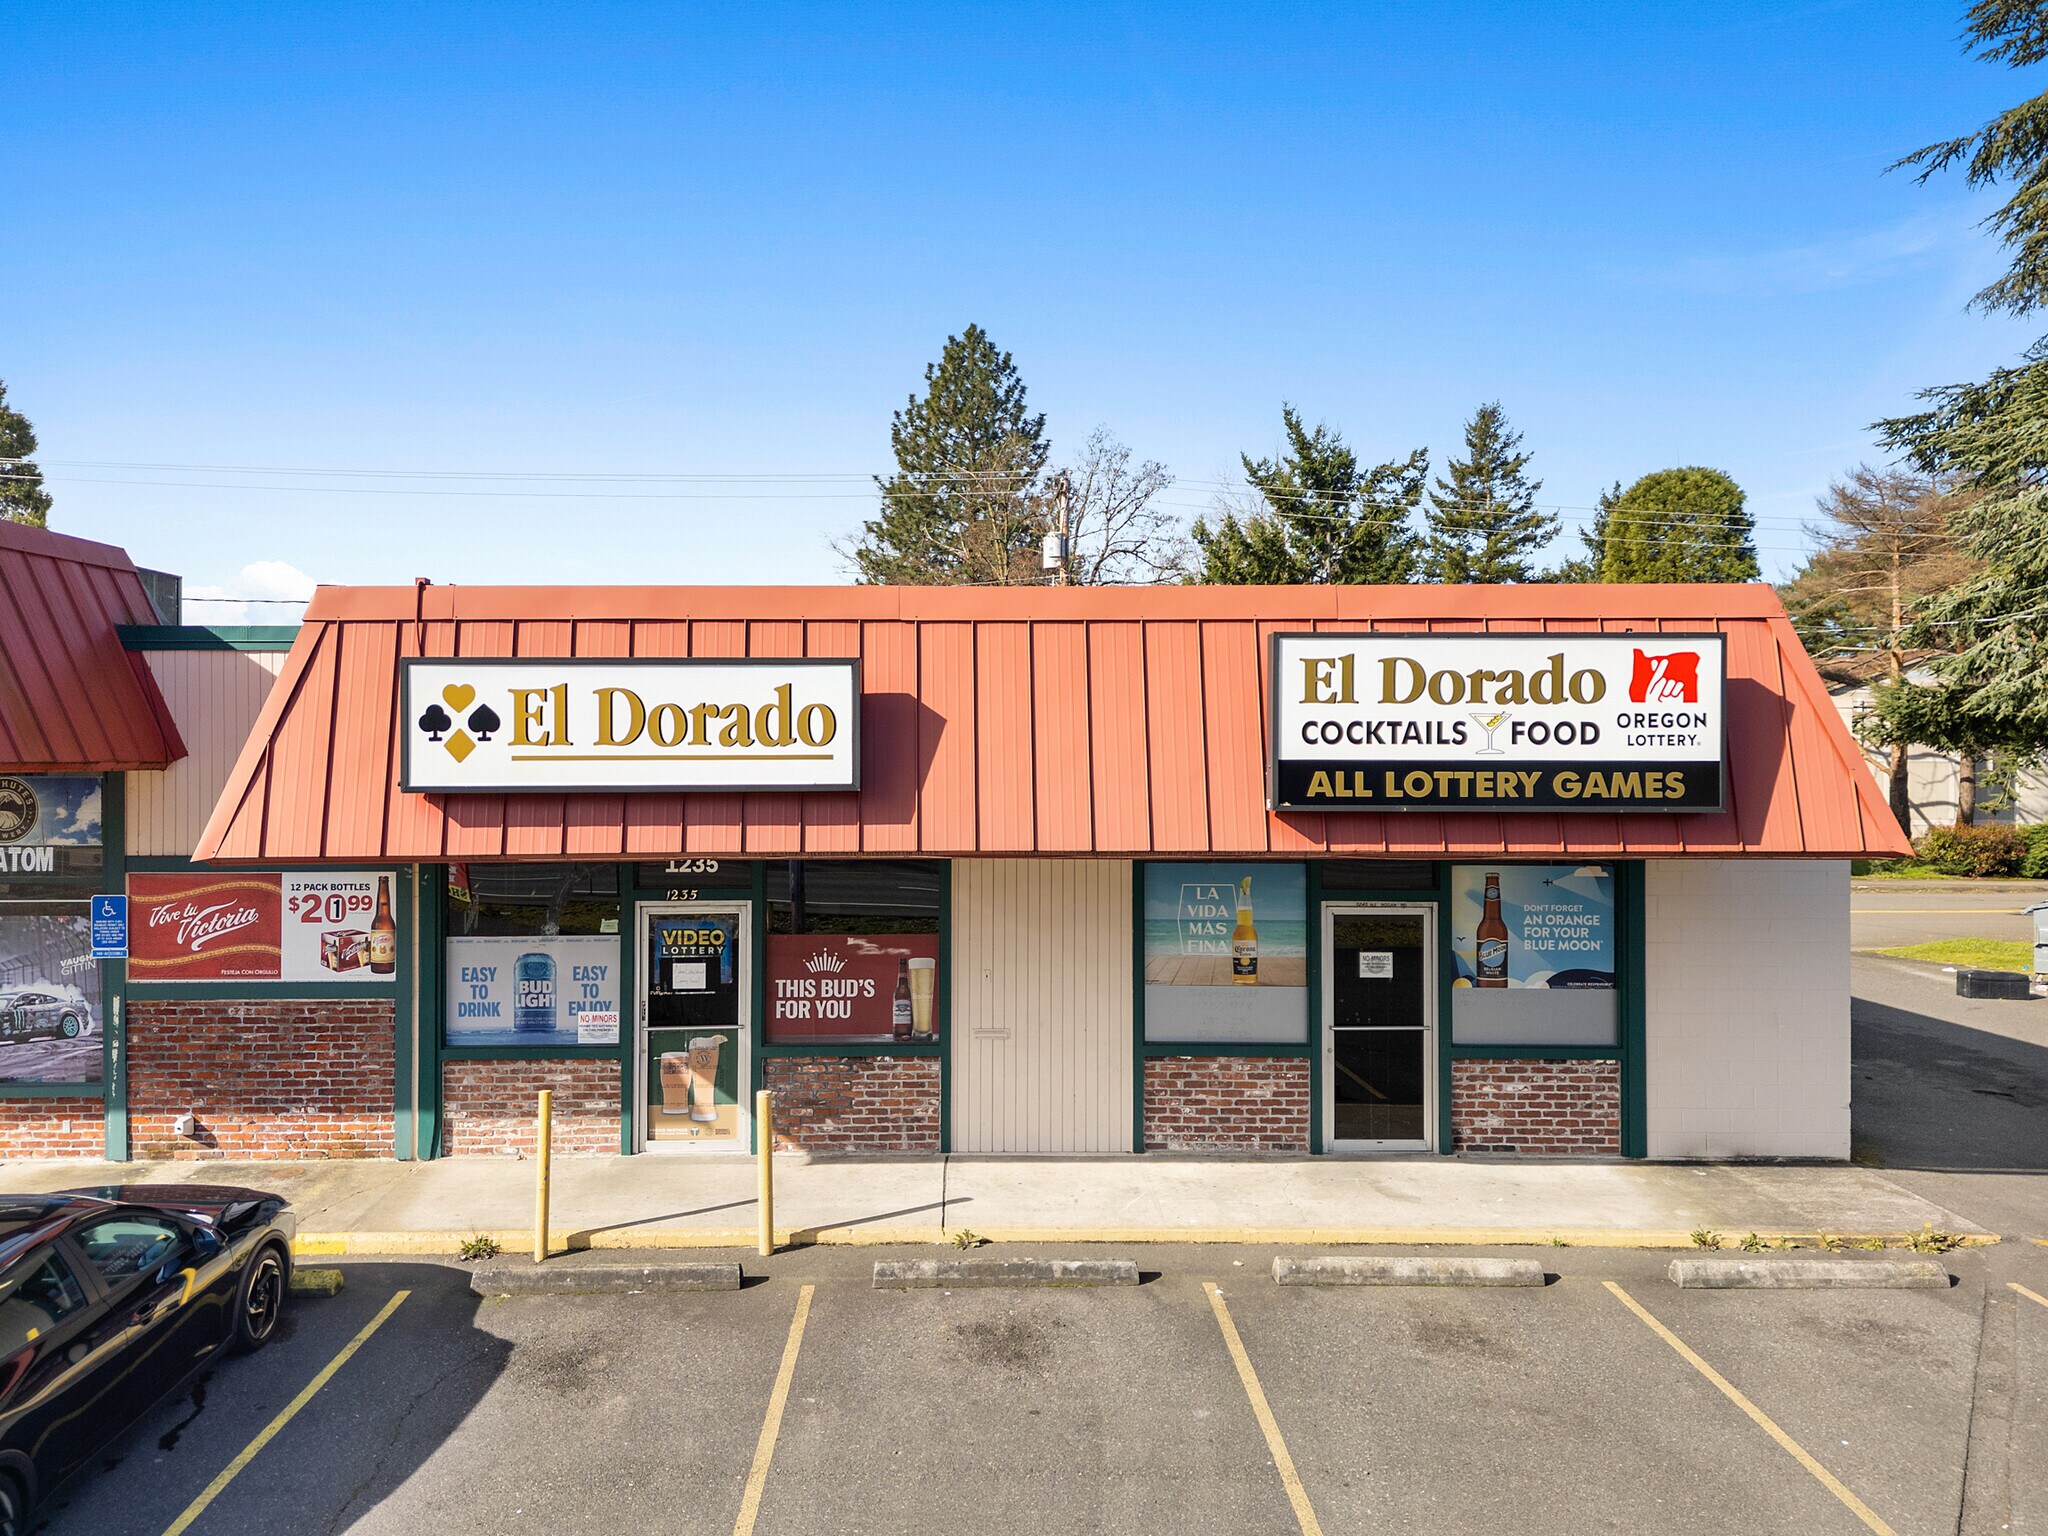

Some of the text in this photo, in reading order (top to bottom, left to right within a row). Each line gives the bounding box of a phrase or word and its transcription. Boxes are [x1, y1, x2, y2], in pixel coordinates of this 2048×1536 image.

[1299, 652, 1607, 705] El Dorado
[508, 683, 837, 747] El Dorado
[1617, 712, 1708, 729] OREGON
[1301, 720, 1468, 746] COCKTAILS
[1511, 720, 1601, 746] FOOD
[1627, 734, 1699, 747] LOTTERY
[1306, 770, 1686, 799] ALL LOTTERY GAMES
[665, 859, 719, 873] 1235
[291, 883, 371, 891] 12 PACK BOTTLES
[1196, 887, 1220, 900] LA
[666, 889, 699, 901] 1235
[149, 902, 199, 928] Vive tu
[1187, 905, 1229, 918] VIDA
[1524, 904, 1549, 913] DON'T
[177, 898, 259, 952] Victoria
[1524, 915, 1600, 926] AN ORANGE
[662, 929, 725, 945] VIDEO
[1524, 927, 1589, 938] FOR YOUR
[662, 946, 724, 955] LOTTERY
[1187, 940, 1229, 953] FINA
[1524, 940, 1601, 951] BLUE MOON
[60, 953, 93, 967] VAUGH
[461, 966, 497, 983] EASY
[572, 965, 608, 982] EASY
[470, 984, 489, 1000] TO
[519, 980, 553, 994] BUD
[581, 983, 600, 999] TO
[775, 979, 876, 998] THIS BUD'S
[515, 994, 556, 1008] LIGHT
[458, 1001, 502, 1018] DRINK
[776, 1000, 851, 1019] FOR YOU
[580, 1014, 618, 1023] NO MINORS
